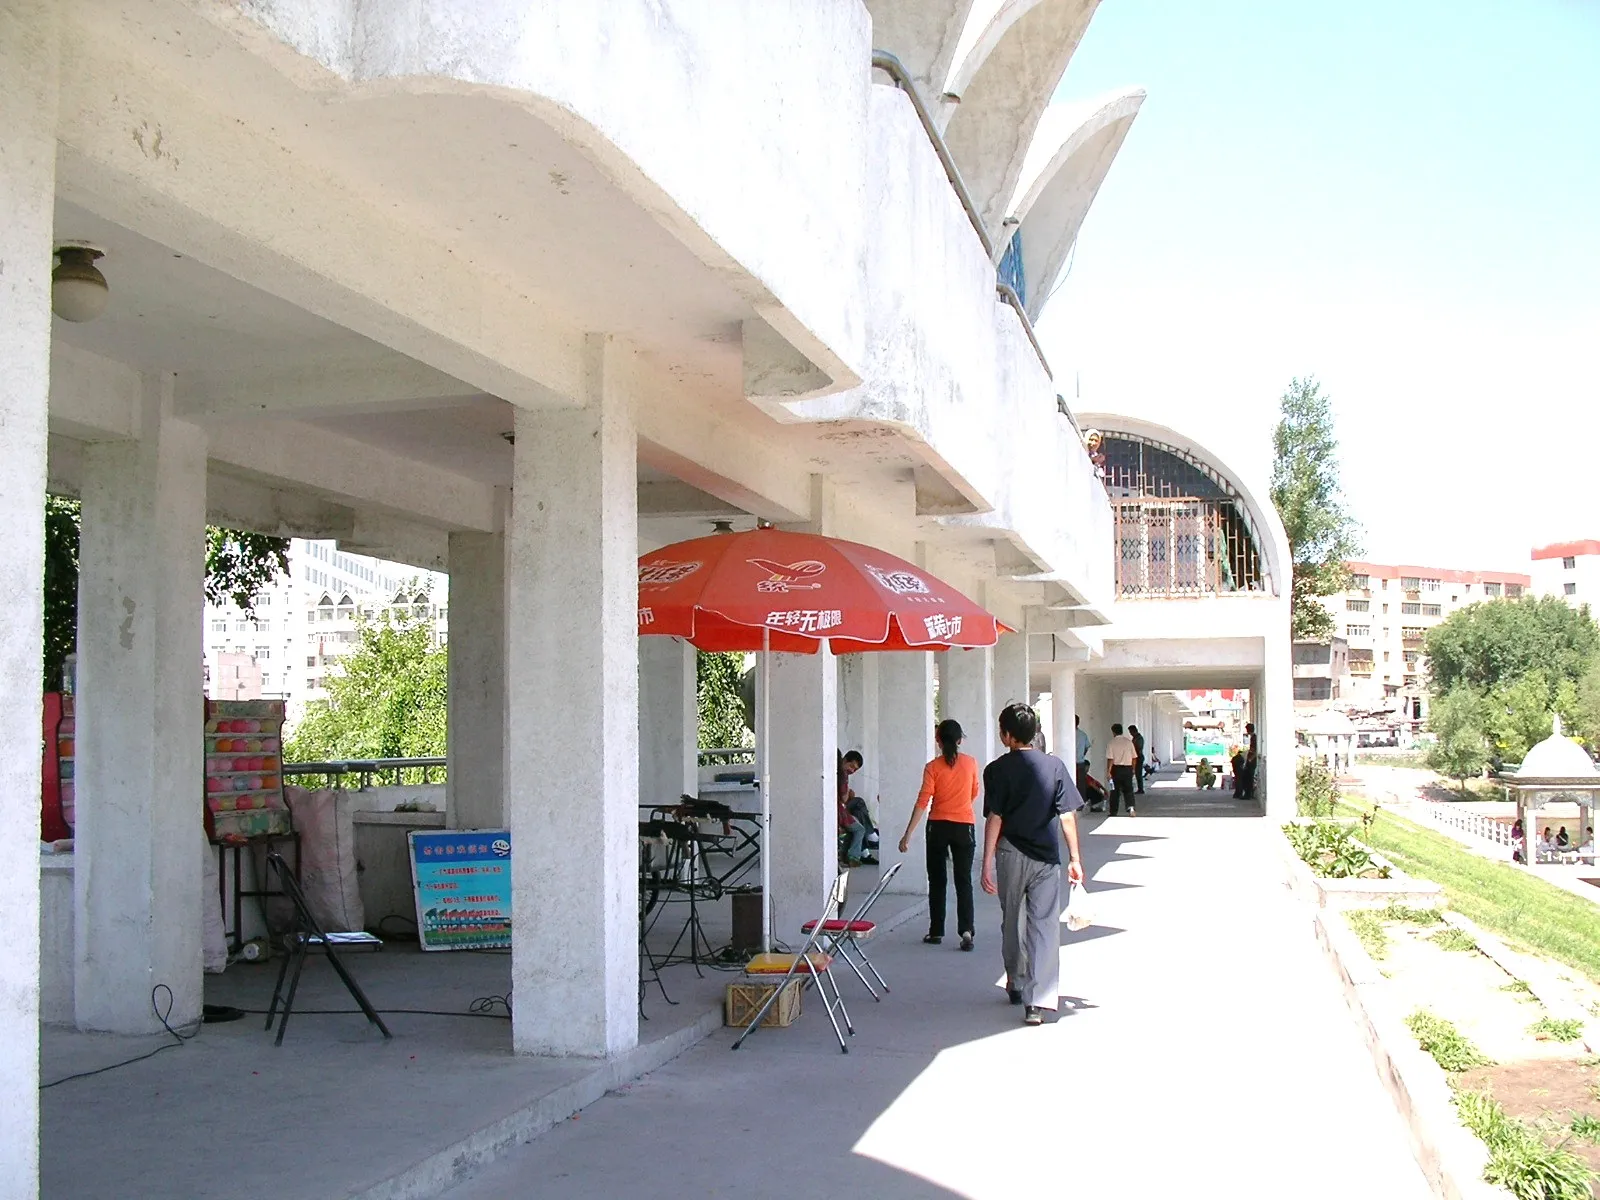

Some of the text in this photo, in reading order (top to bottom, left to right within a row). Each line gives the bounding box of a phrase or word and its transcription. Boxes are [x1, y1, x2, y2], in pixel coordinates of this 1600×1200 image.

[765, 609, 842, 632] 年轻无极限
[923, 613, 962, 640] 新装上市
